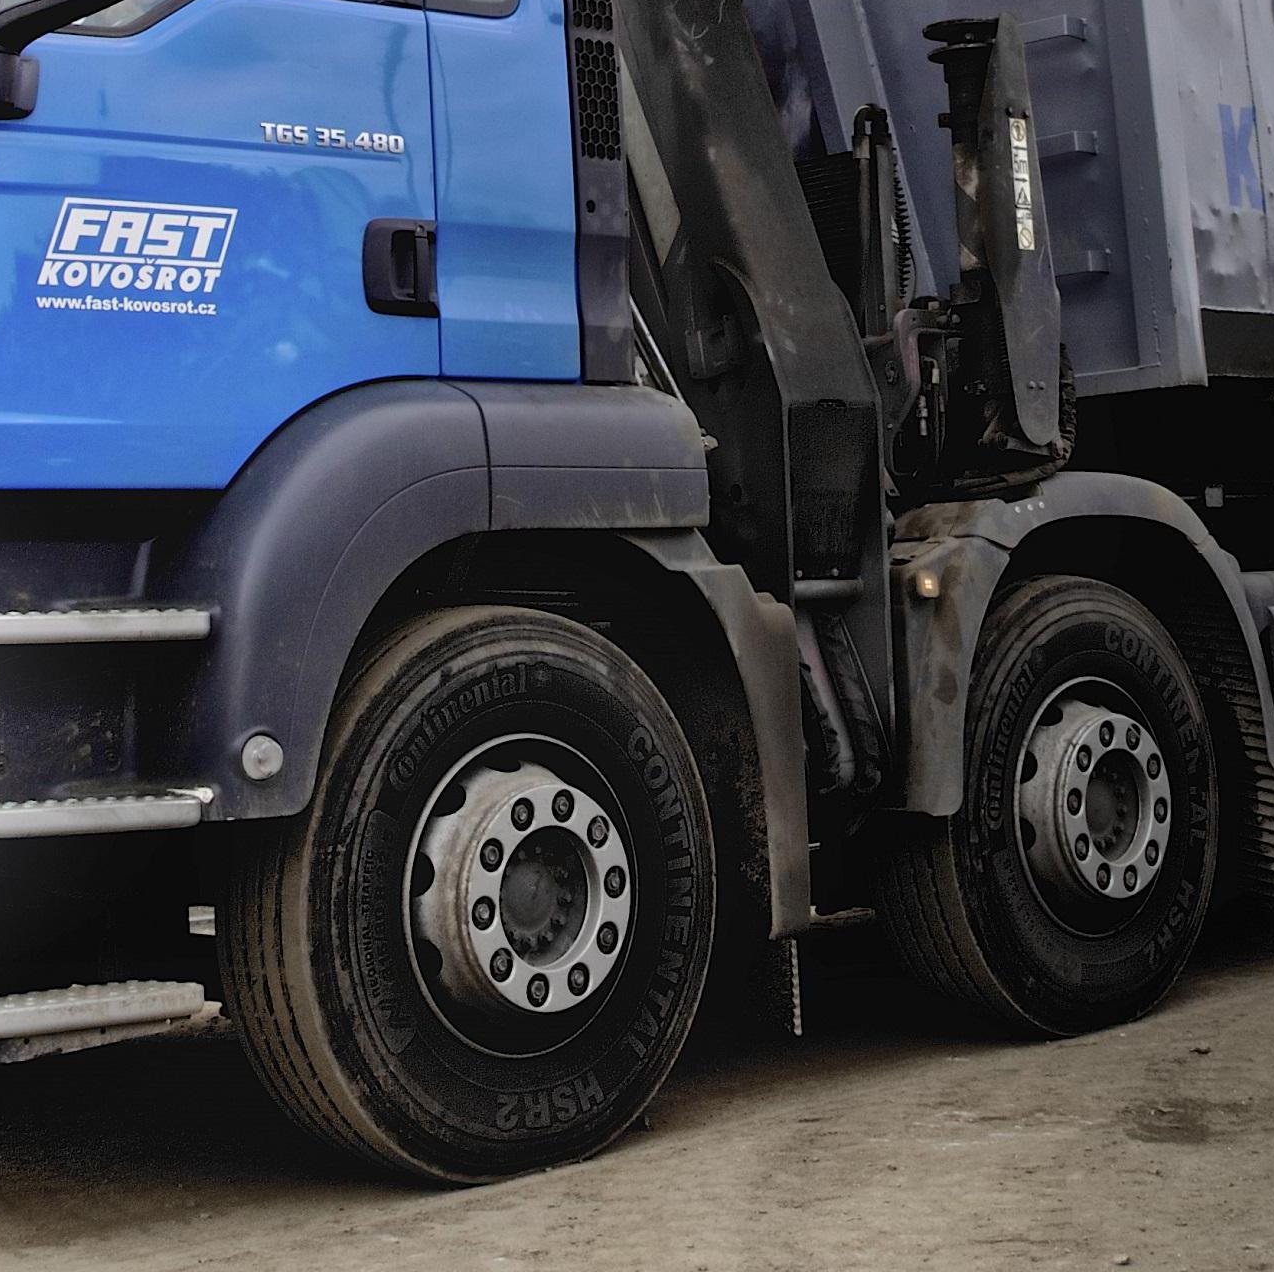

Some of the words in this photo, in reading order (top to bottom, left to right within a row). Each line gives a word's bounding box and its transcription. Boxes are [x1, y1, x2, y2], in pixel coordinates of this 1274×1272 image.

[260, 122, 309, 146] TGS
[315, 127, 405, 154] 35.480
[58, 208, 228, 259] FAST
[36, 258, 222, 293] KOVOŠROT
[36, 294, 217, 315] www.fast-kovosrot.cz
[360, 849, 375, 917] TRAFFIC
[627, 725, 694, 1062] CONTINENTAL
[495, 1070, 606, 1133] HSR2
